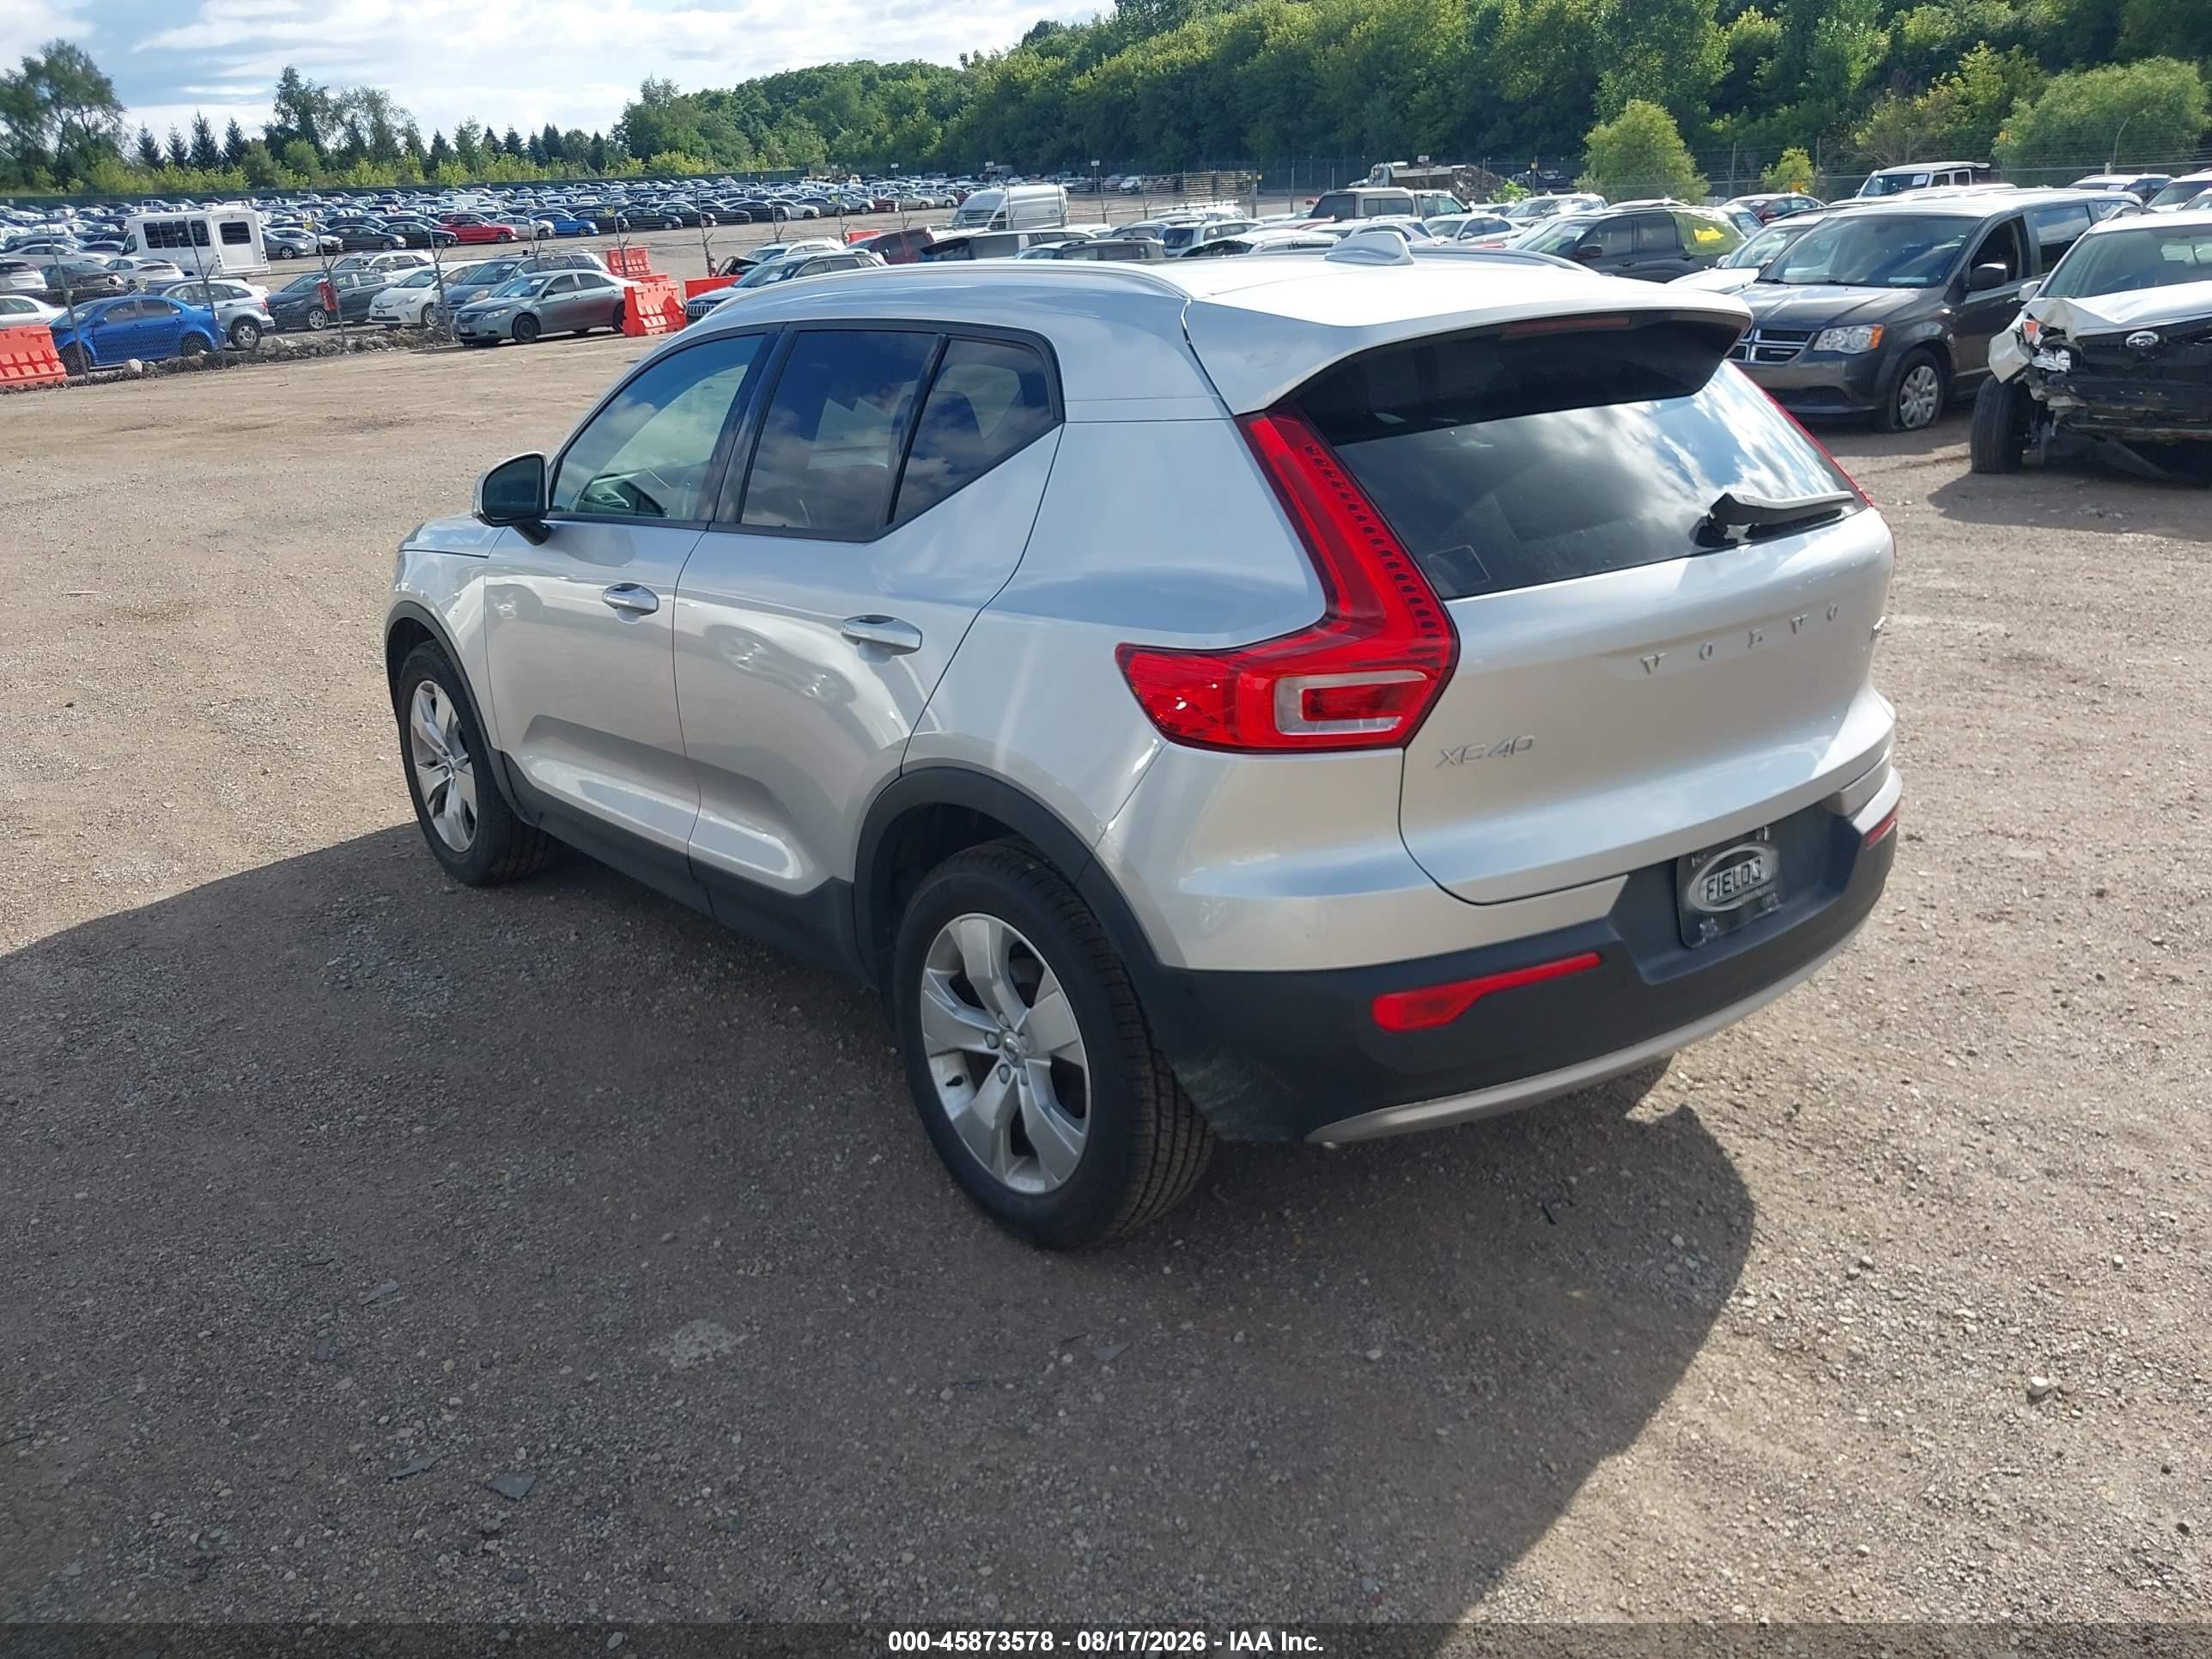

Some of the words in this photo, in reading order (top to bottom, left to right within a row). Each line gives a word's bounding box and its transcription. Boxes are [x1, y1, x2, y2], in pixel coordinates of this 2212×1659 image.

[1639, 603, 1838, 674] VOLVO
[1435, 734, 1535, 769] XC40
[1705, 856, 1762, 902] FIELDS
